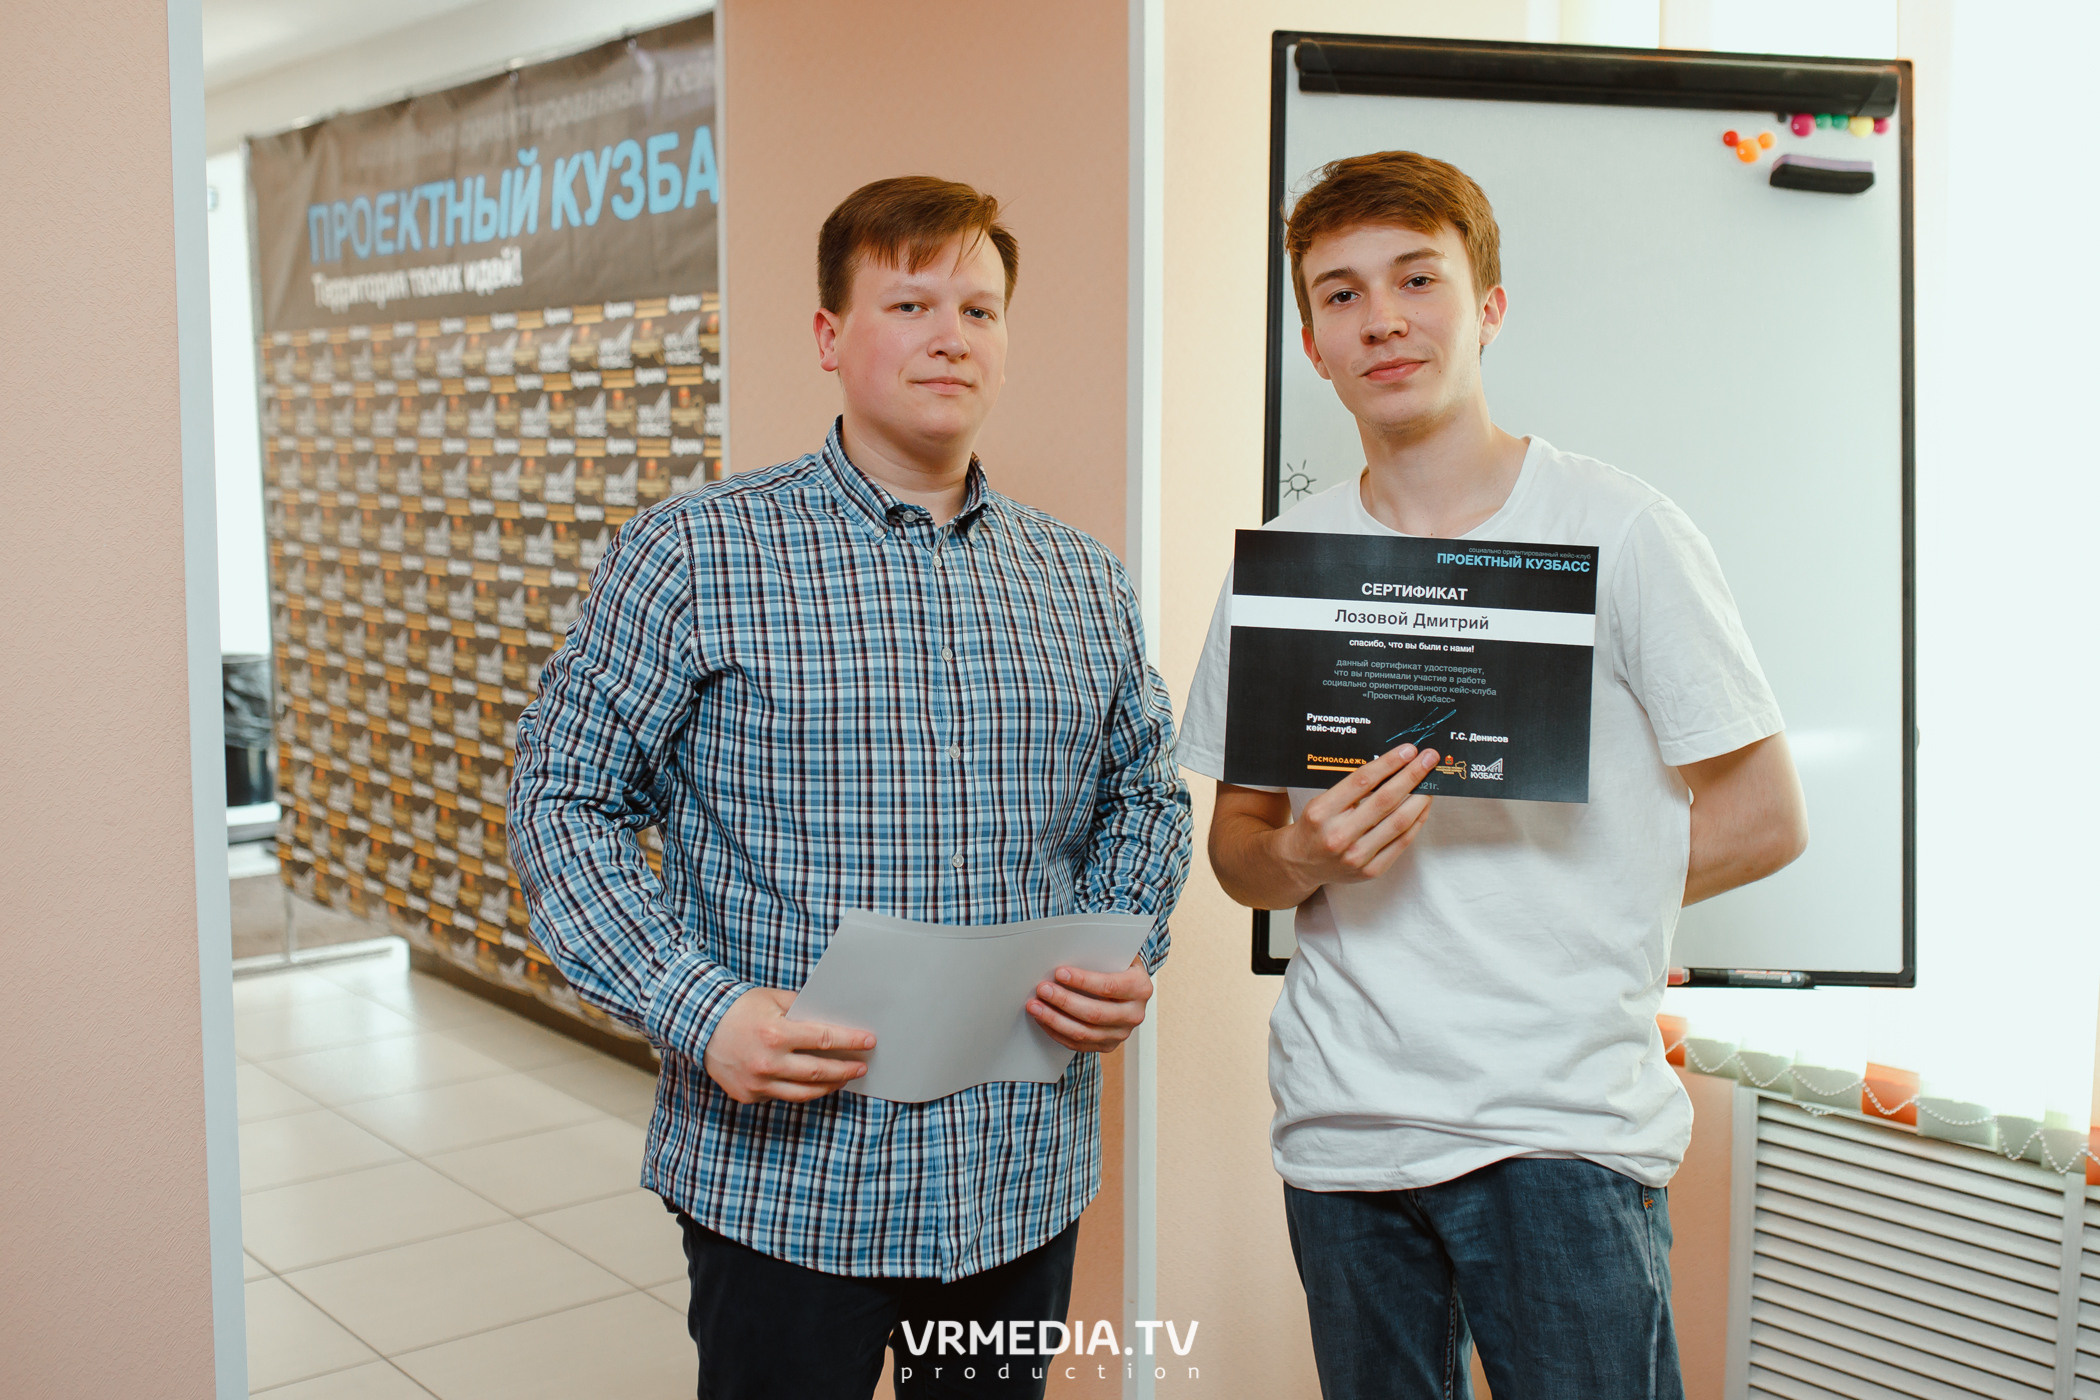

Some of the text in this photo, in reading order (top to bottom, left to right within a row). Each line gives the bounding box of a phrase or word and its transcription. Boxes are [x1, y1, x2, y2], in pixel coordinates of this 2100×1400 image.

[307, 146, 542, 264] ПРОЕКТНЫЙ
[551, 125, 720, 231] КУЗБА
[1469, 547, 1591, 561] социально ориентированный кейс-клуб
[1437, 553, 1590, 572] ПРОЕКТНЫЙ КУЗБАСС
[1361, 582, 1468, 600] СЕРТИФИКАТ
[1335, 609, 1489, 631] Лозовой Дмитрий
[1349, 639, 1386, 649] спасибо,
[1388, 641, 1403, 649] что
[1405, 642, 1417, 650] вы
[1419, 642, 1441, 651] были
[1450, 644, 1475, 653] нами!
[1336, 659, 1485, 675] данный сертификат удостоверяет,
[1334, 669, 1348, 677] что
[1364, 671, 1411, 680] принимали
[1413, 674, 1447, 684] участие
[1456, 676, 1486, 685] работе
[1322, 679, 1497, 696] социально ориентированного кейс-клуба
[1362, 691, 1455, 703] «Проектный Кузбасс»
[1306, 713, 1371, 724] Руководитель
[1306, 724, 1357, 735] кейс-клуба
[1450, 731, 1509, 743] Г.С. Денисов
[1470, 772, 1503, 780] КУЗБАСС
